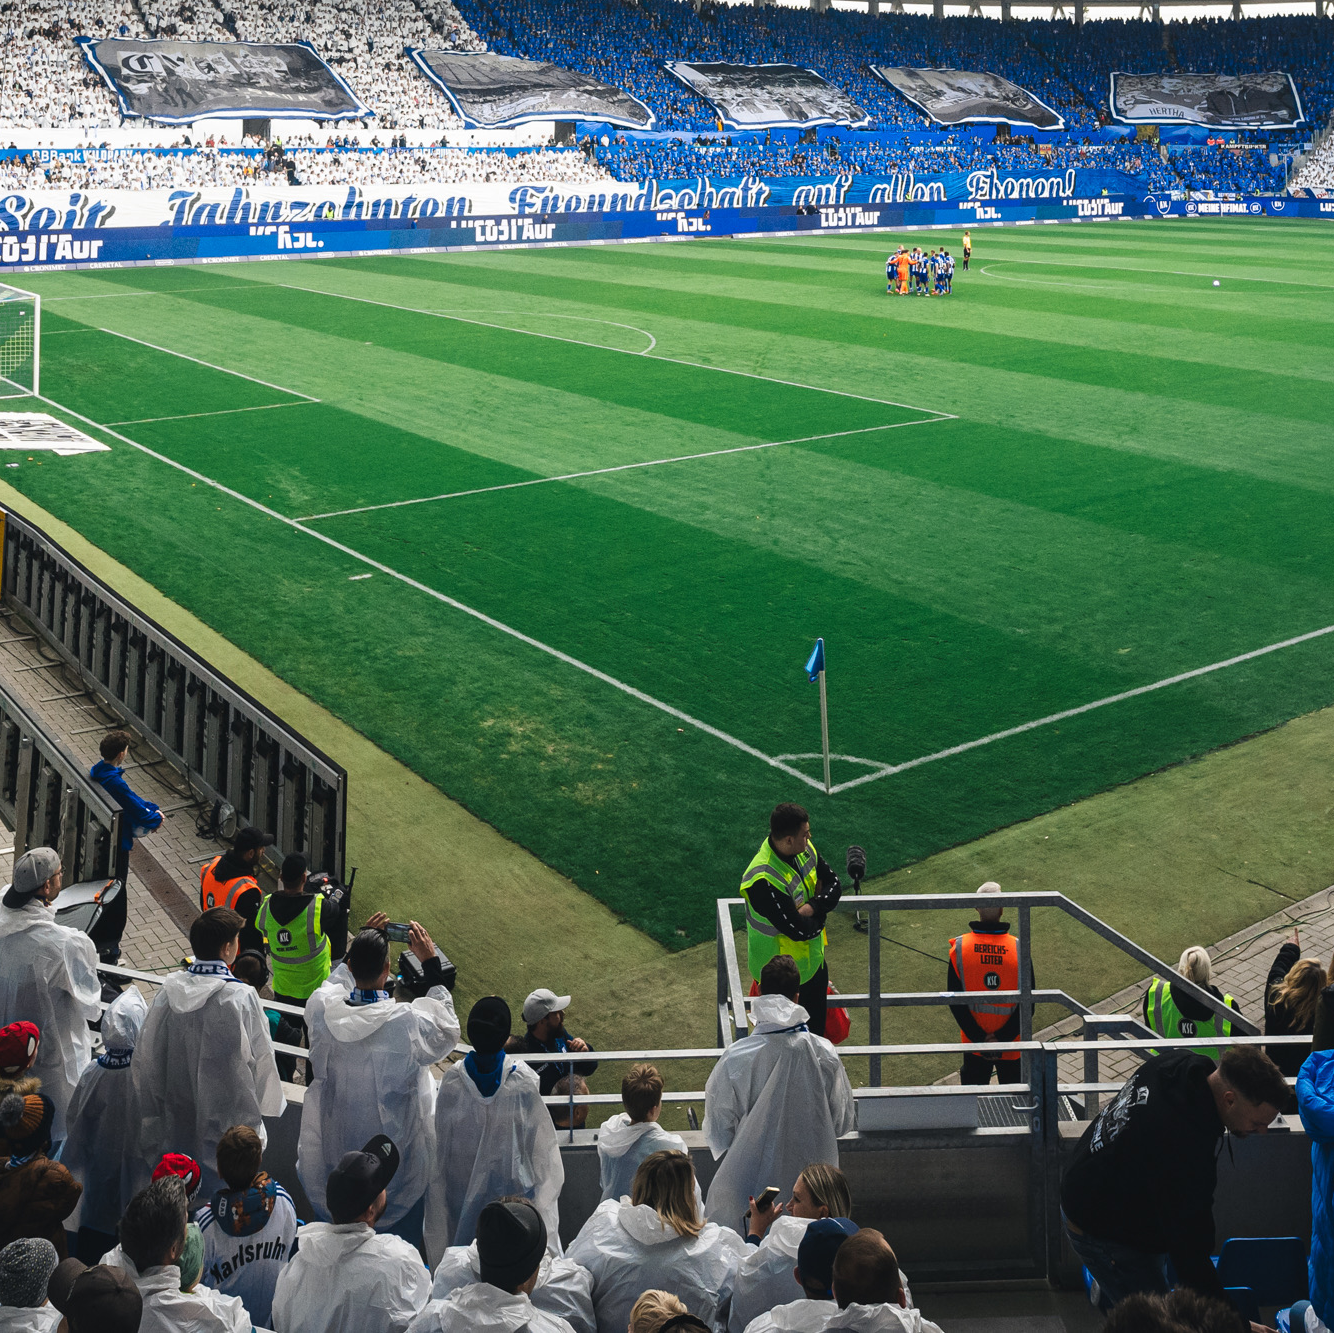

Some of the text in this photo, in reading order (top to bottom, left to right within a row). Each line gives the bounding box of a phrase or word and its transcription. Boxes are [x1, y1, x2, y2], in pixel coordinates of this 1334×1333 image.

[1150, 107, 1184, 118] HERTHA
[30, 264, 66, 272] CRONIMET
[279, 932, 289, 943] KSC
[974, 943, 1009, 955] BEREICHS-
[980, 954, 1003, 966] LEITER
[987, 976, 998, 986] KSC
[1181, 1022, 1194, 1034] KSC
